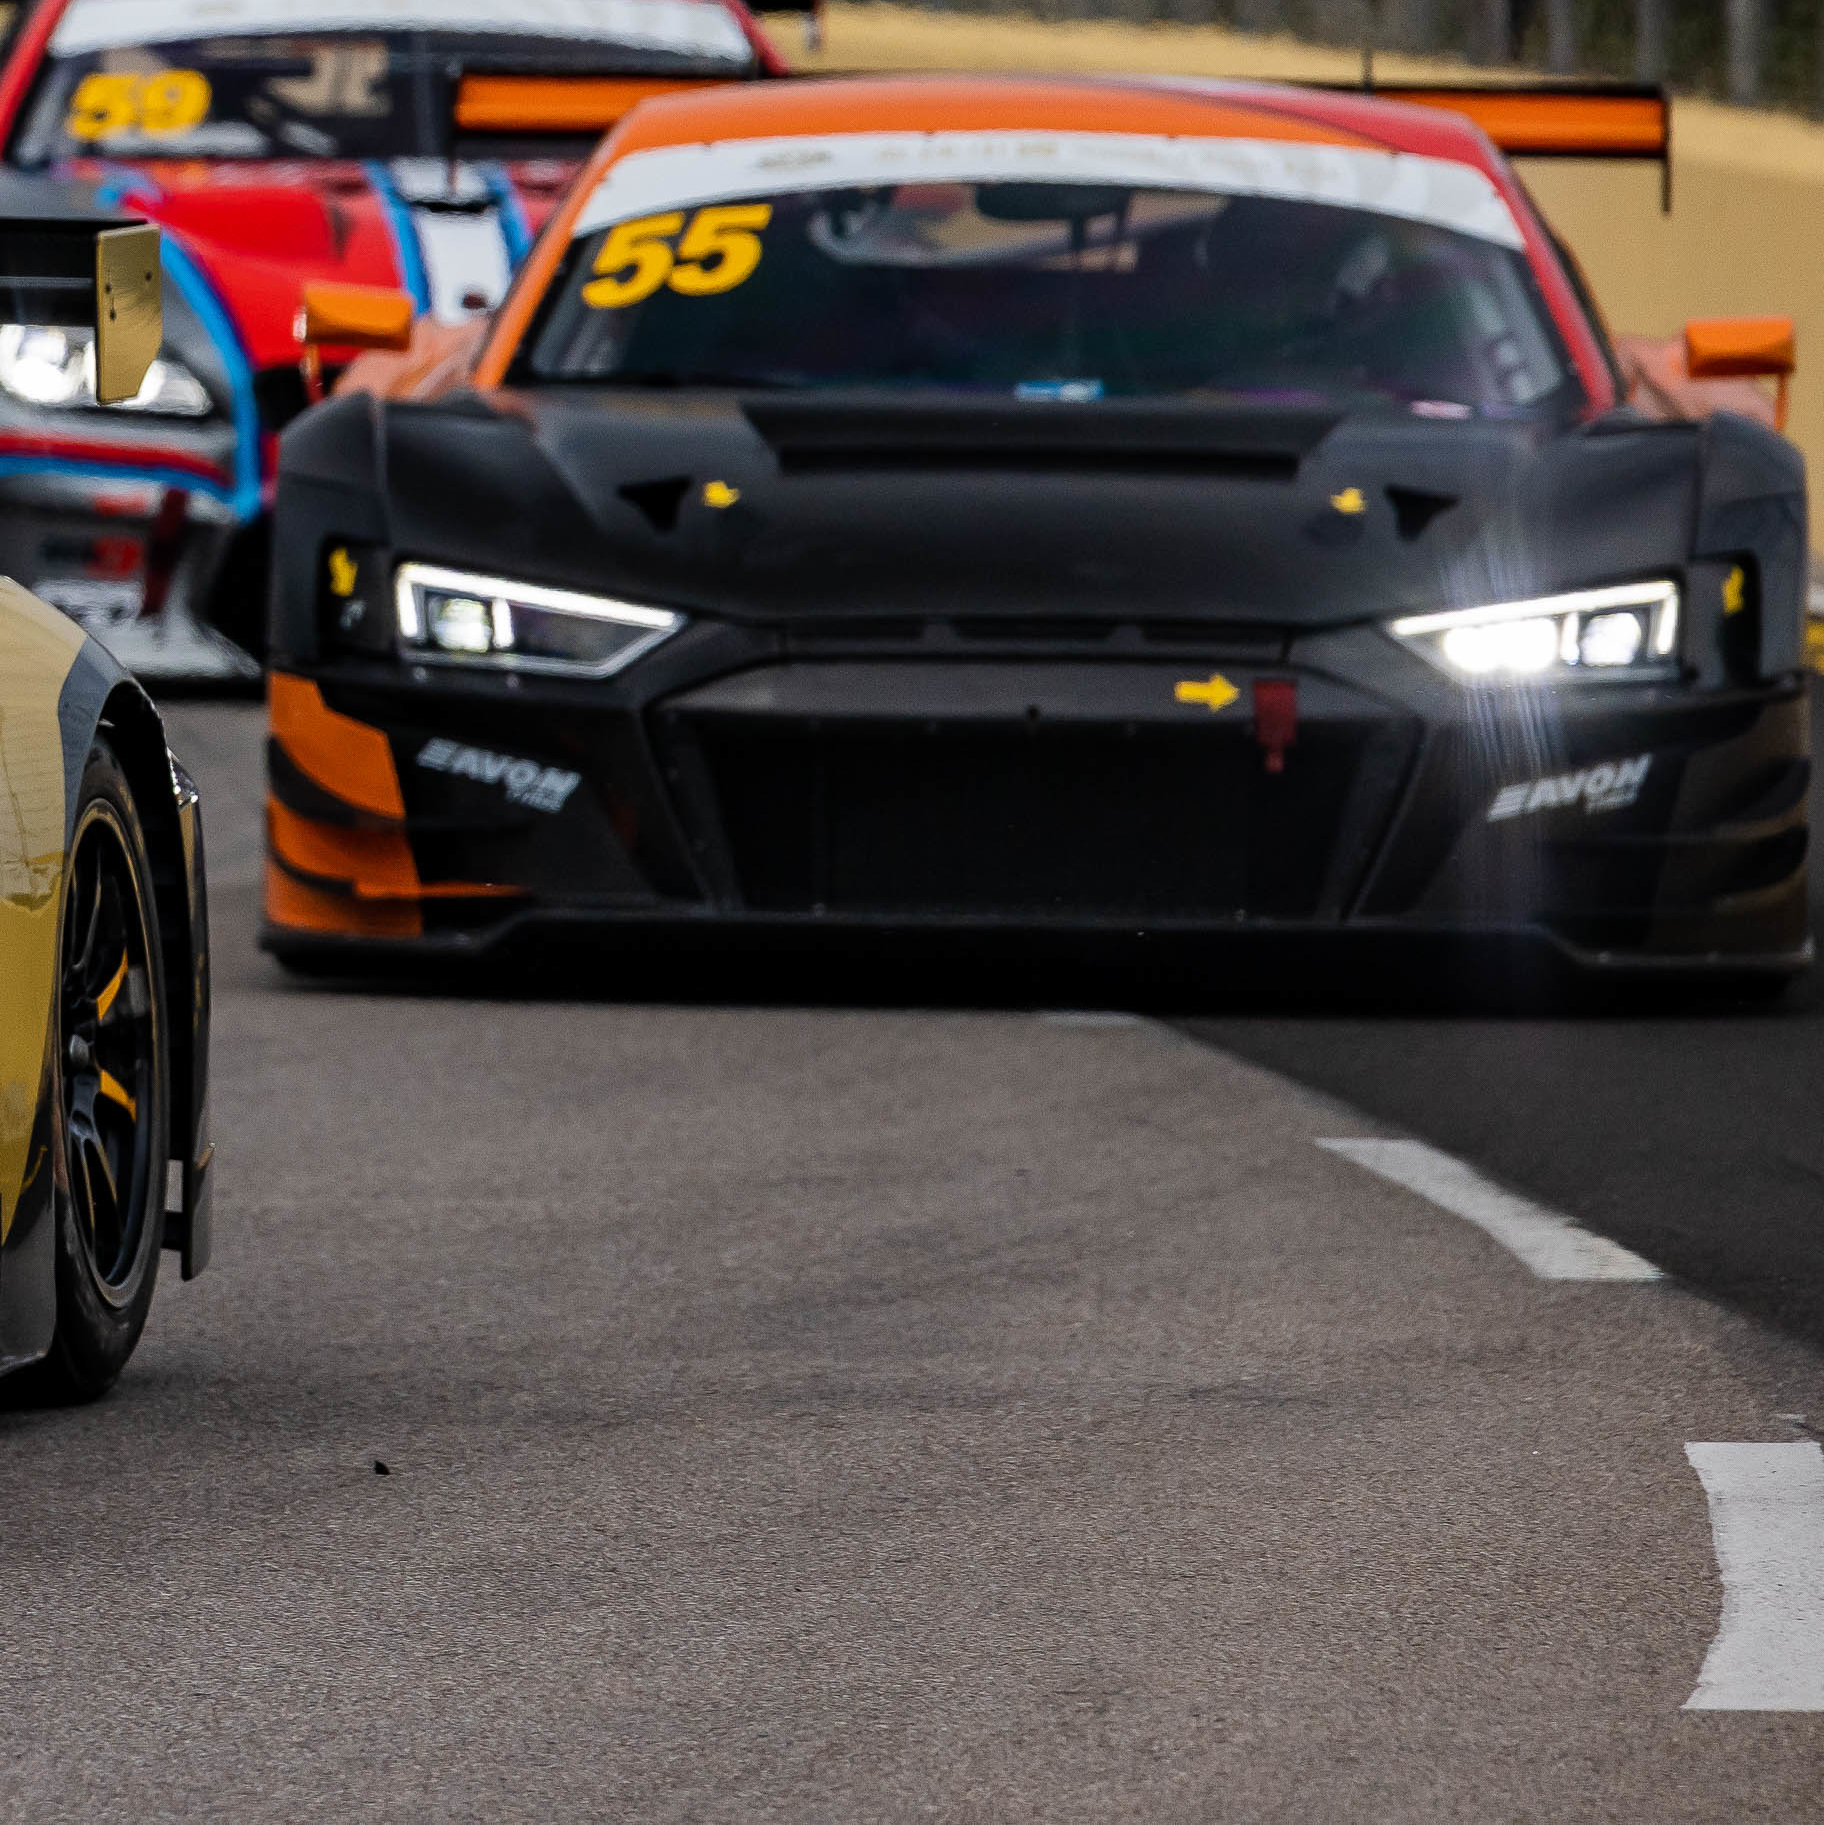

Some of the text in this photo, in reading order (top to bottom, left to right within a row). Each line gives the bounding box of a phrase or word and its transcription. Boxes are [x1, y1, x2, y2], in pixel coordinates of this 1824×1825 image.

[65, 67, 213, 143] 59
[581, 203, 774, 309] 55
[452, 746, 582, 794] AVON
[1526, 752, 1653, 813] AVON
